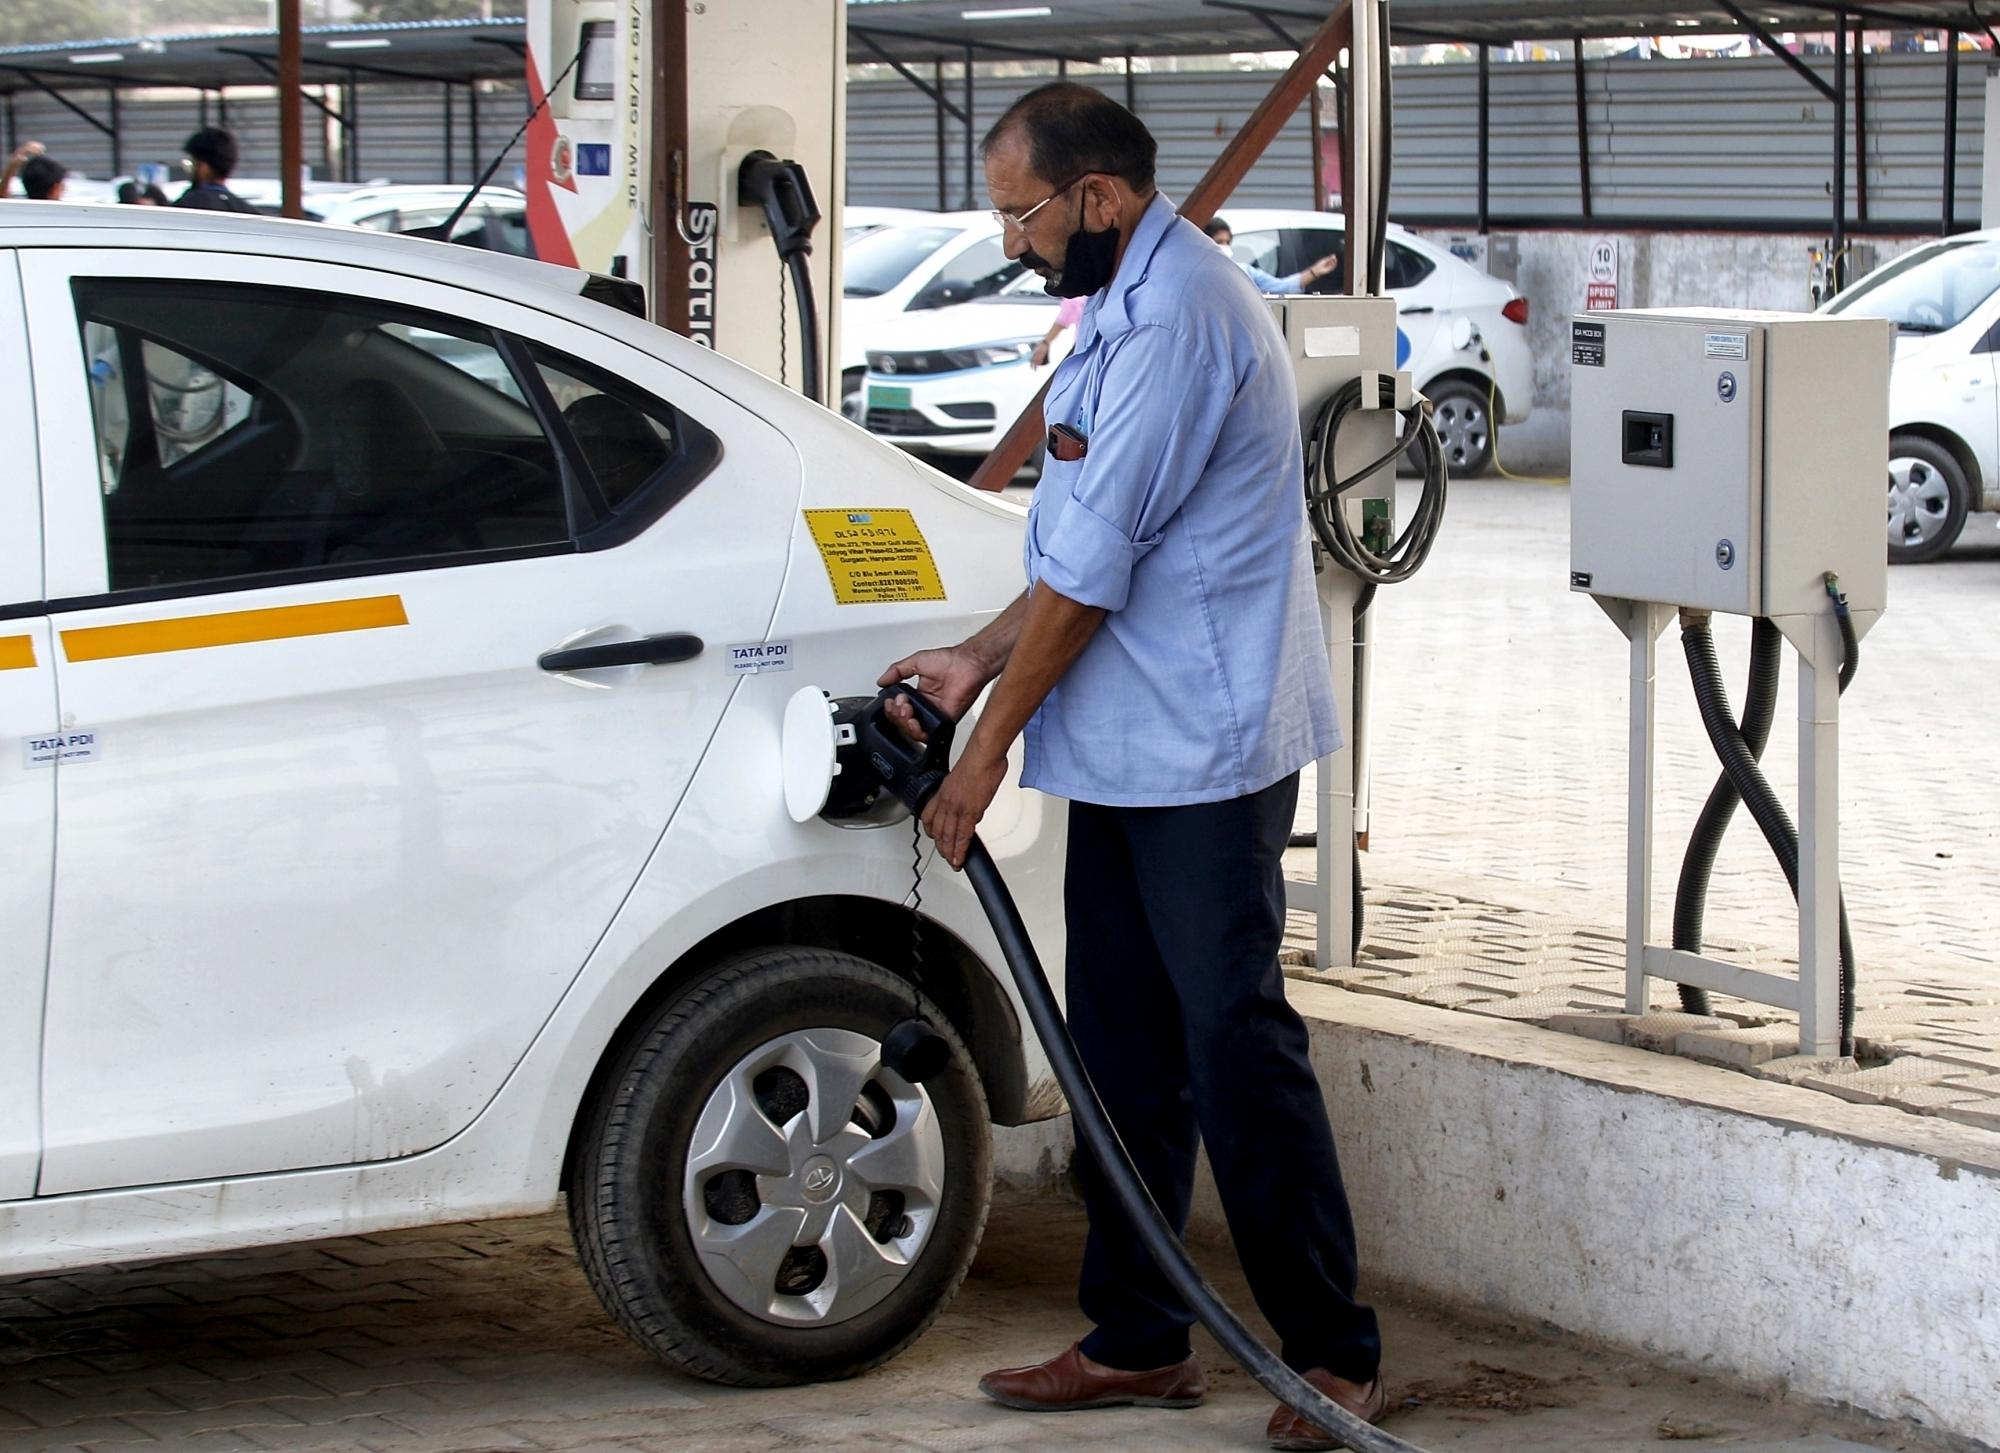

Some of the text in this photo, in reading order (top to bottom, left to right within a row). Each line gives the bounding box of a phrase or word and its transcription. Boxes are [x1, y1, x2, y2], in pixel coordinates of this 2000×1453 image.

[631, 0, 642, 46] GB/
[629, 144, 639, 178] kW
[1597, 248, 1610, 263] 10
[1589, 287, 1616, 298] SPEED
[1589, 298, 1615, 310] LIMIT
[893, 569, 918, 577] Mobility
[732, 645, 787, 658] TATA PDI
[30, 734, 94, 750] TATA PDI
